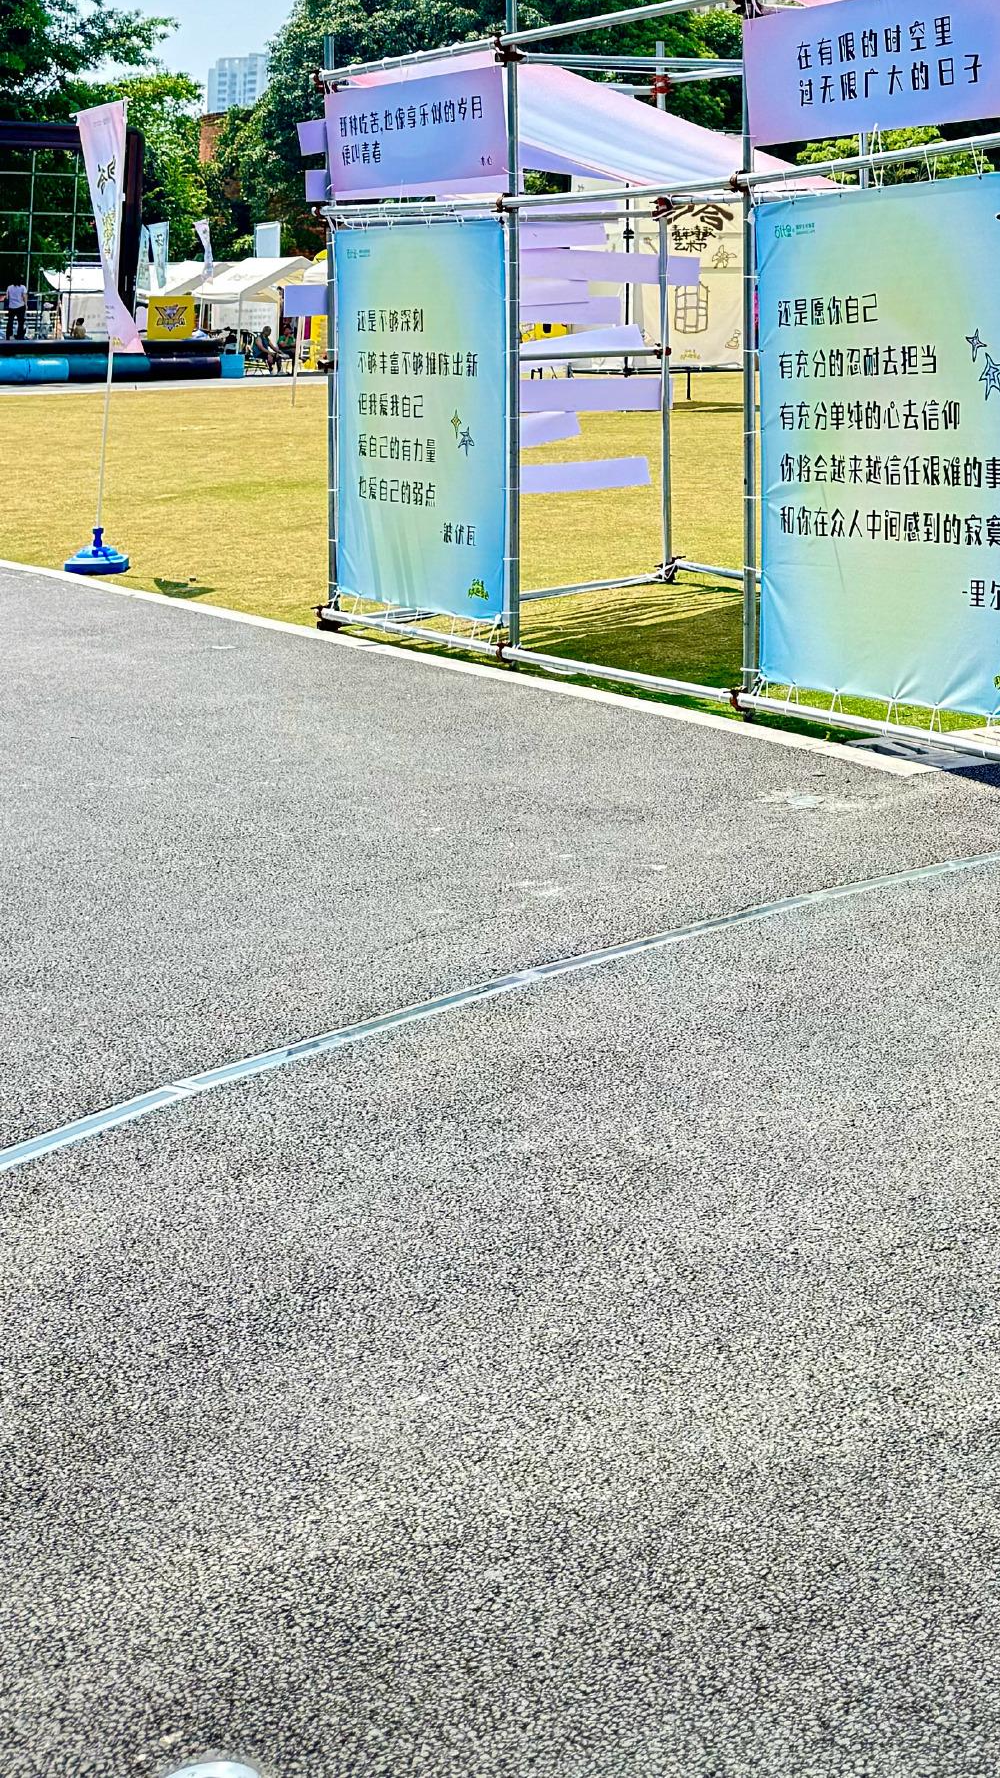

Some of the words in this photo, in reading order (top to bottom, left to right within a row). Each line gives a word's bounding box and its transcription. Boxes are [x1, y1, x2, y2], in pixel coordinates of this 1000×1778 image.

[797, 16, 953, 70] 在有限的时空里
[799, 54, 983, 106] 过无限广大的日子
[342, 140, 381, 166] 便叫青春
[357, 308, 425, 333] 还是不够深刻
[777, 293, 879, 327] 还是愿你自己
[357, 351, 479, 377] 不够丰富不够推陈出新
[778, 344, 938, 379] 有充分的忍耐去担当
[358, 393, 424, 419] 但我爱我自己
[779, 399, 961, 431] 有充分单纯的心去信仰
[358, 433, 437, 463] 爱自己的有力量
[358, 475, 436, 508] 也爱自己的弱点
